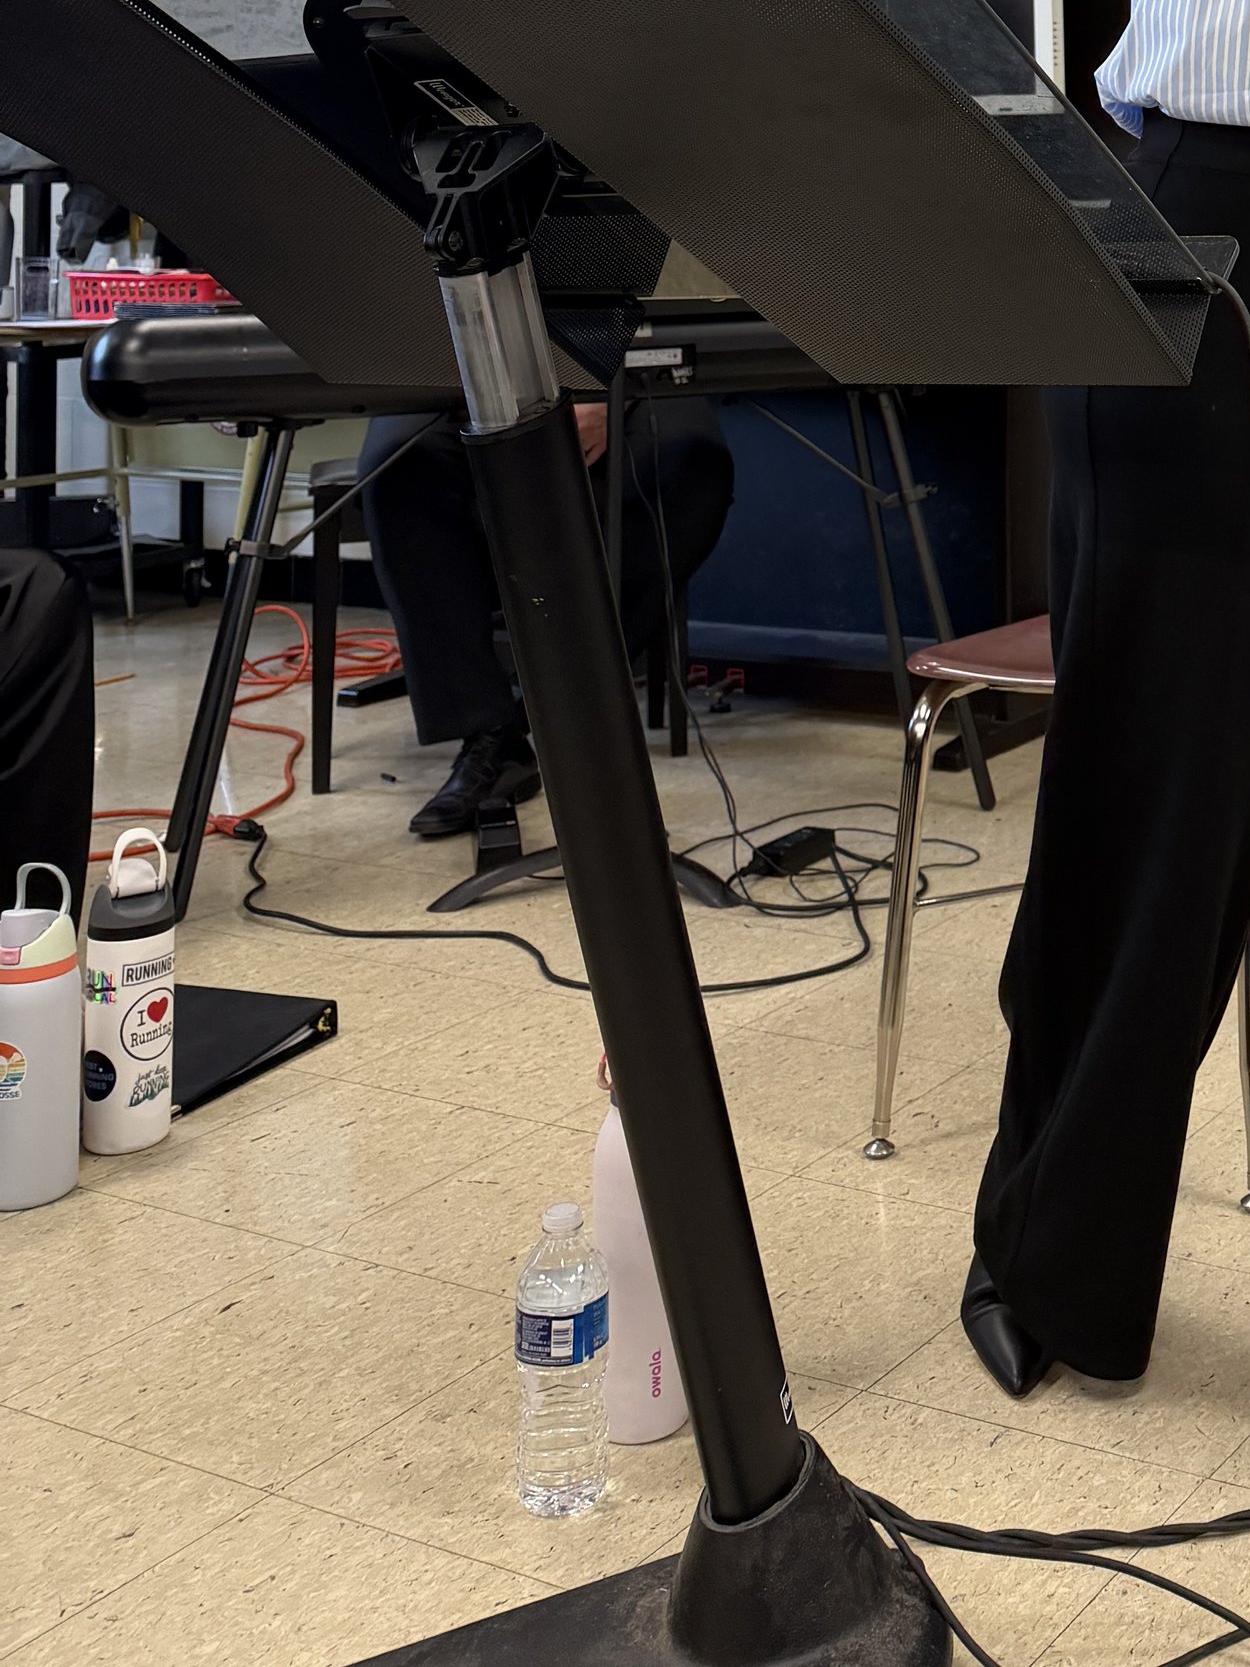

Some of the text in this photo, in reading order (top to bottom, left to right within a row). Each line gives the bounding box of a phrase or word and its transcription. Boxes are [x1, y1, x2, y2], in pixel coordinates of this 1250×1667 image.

[126, 956, 172, 983] RUNNING
[137, 1009, 146, 1027] I
[130, 1020, 172, 1048] Running
[649, 1349, 662, 1398] owala
